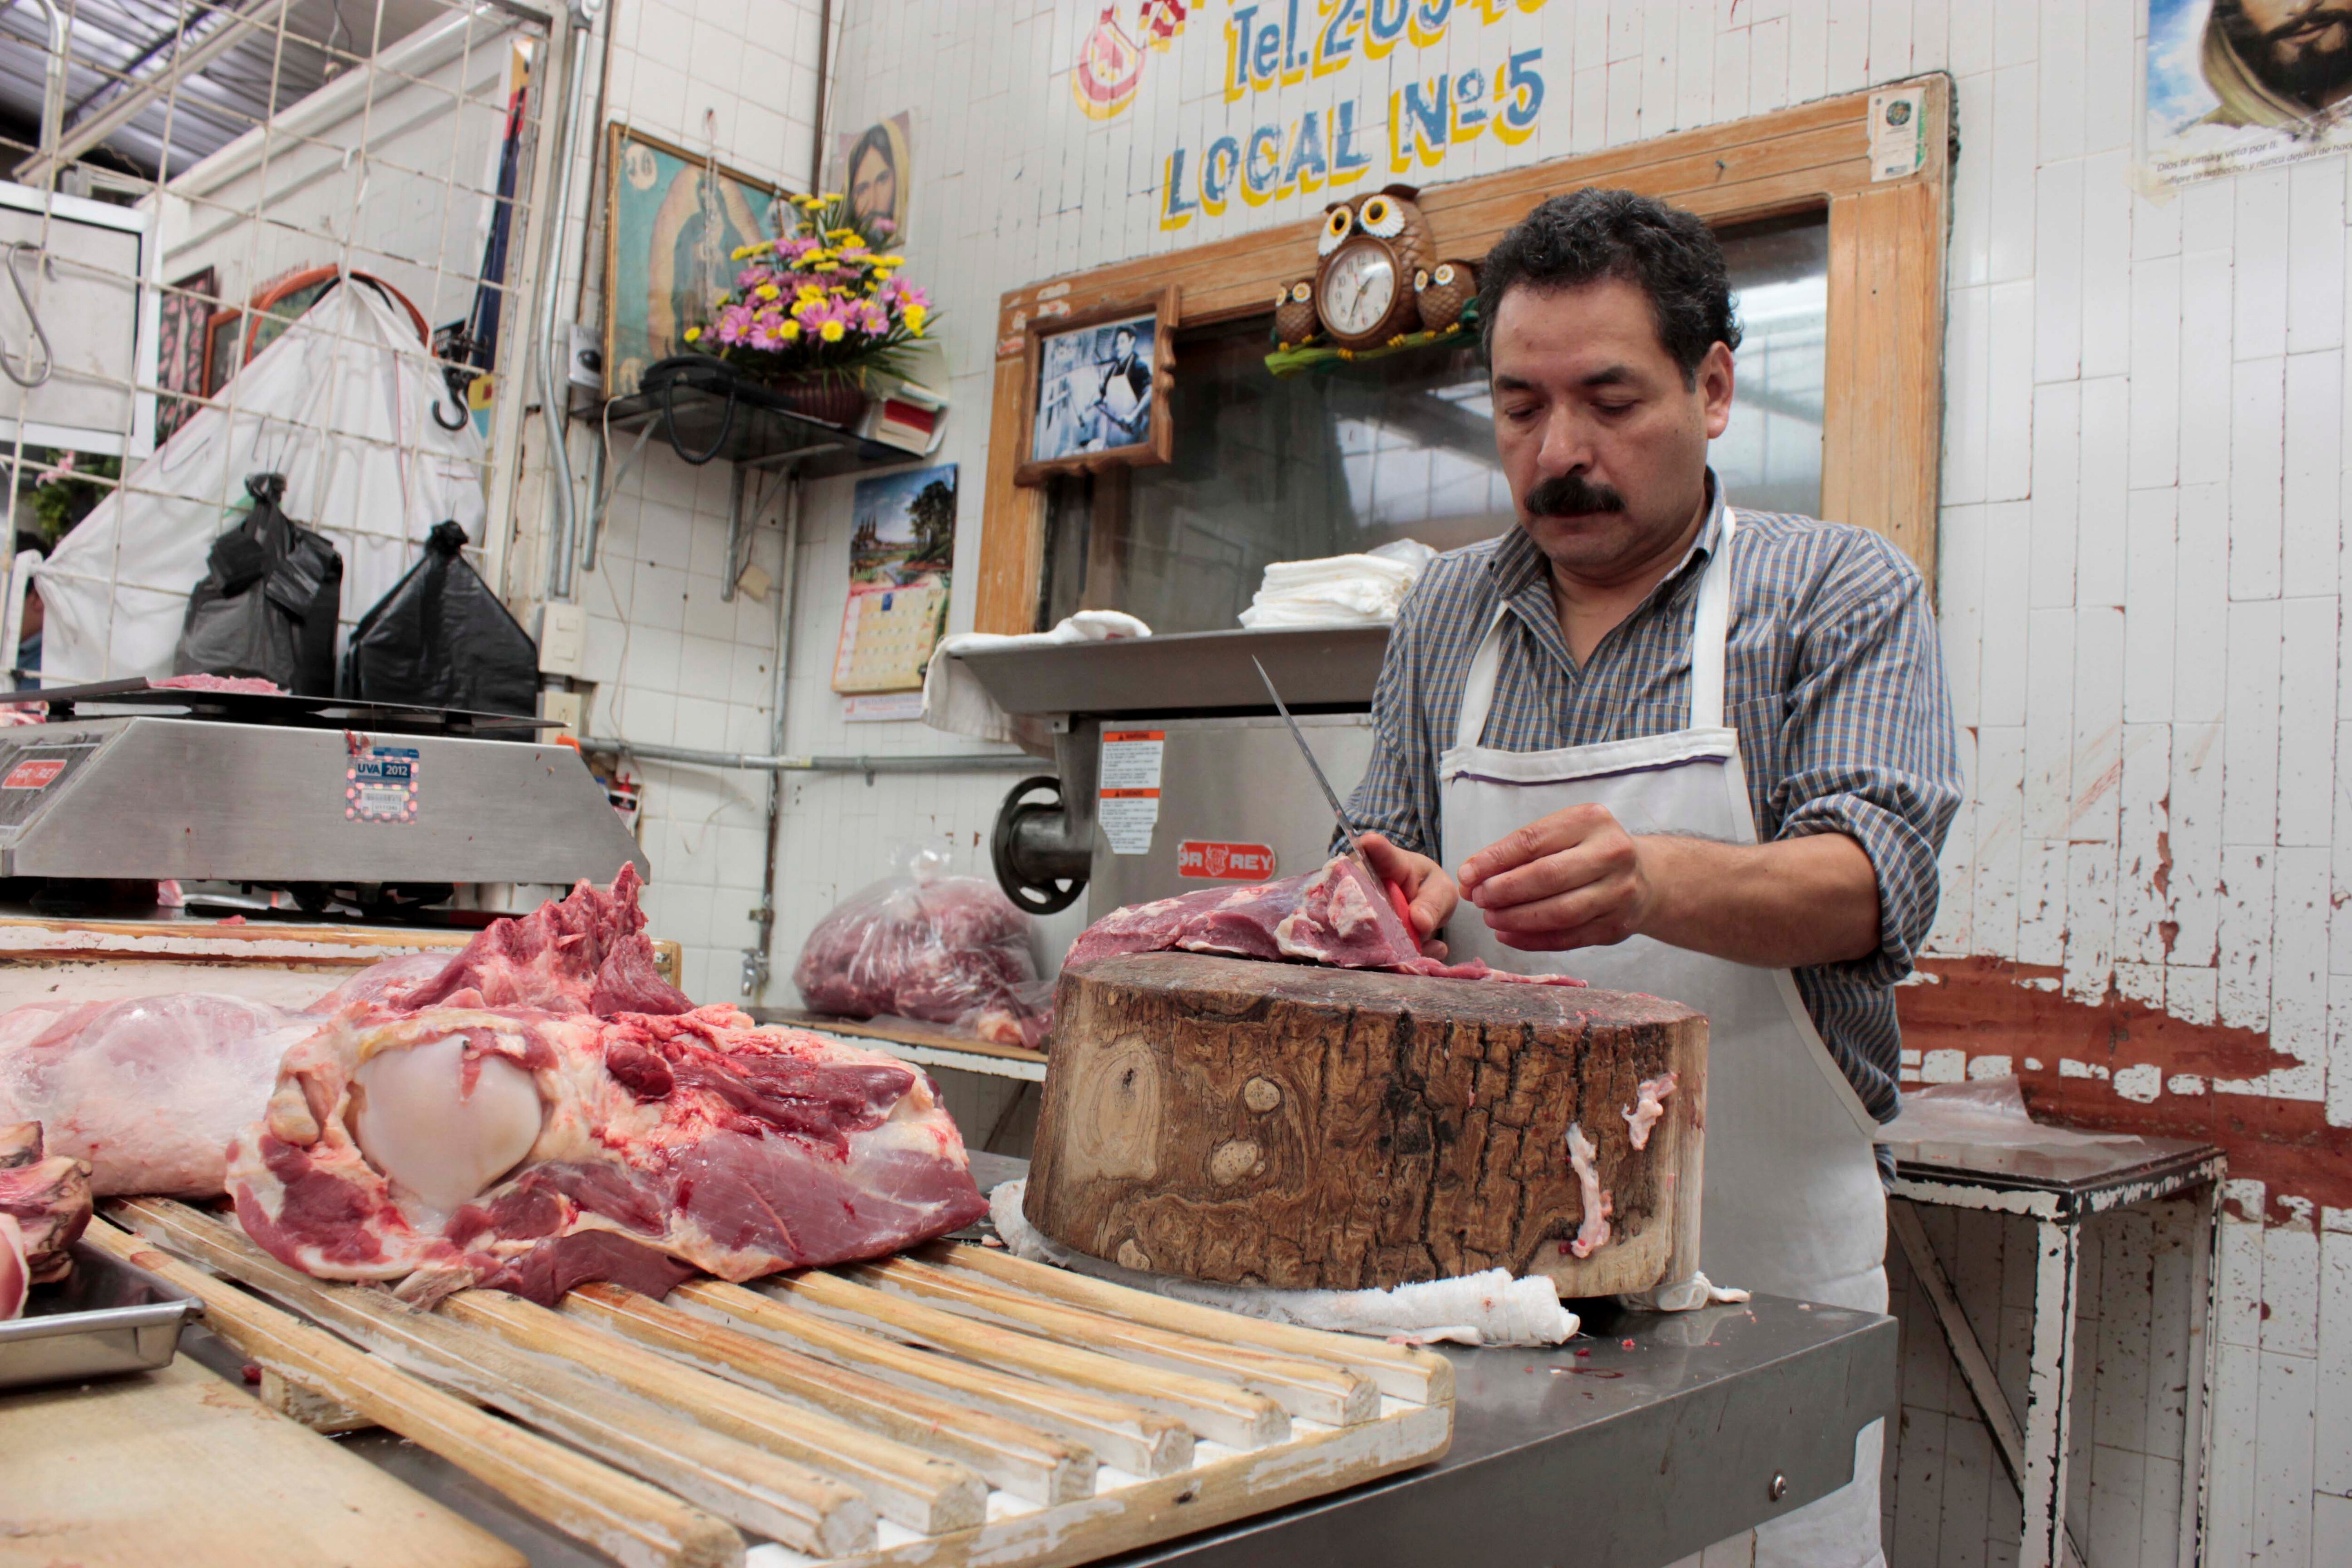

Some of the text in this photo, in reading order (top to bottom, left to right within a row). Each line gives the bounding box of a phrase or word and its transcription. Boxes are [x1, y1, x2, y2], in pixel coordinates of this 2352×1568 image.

[1168, 99, 1373, 215] LOCAL
[1506, 47, 1545, 127] 5
[358, 763, 408, 776] UVA 2012
[1230, 854, 1273, 870] REY
